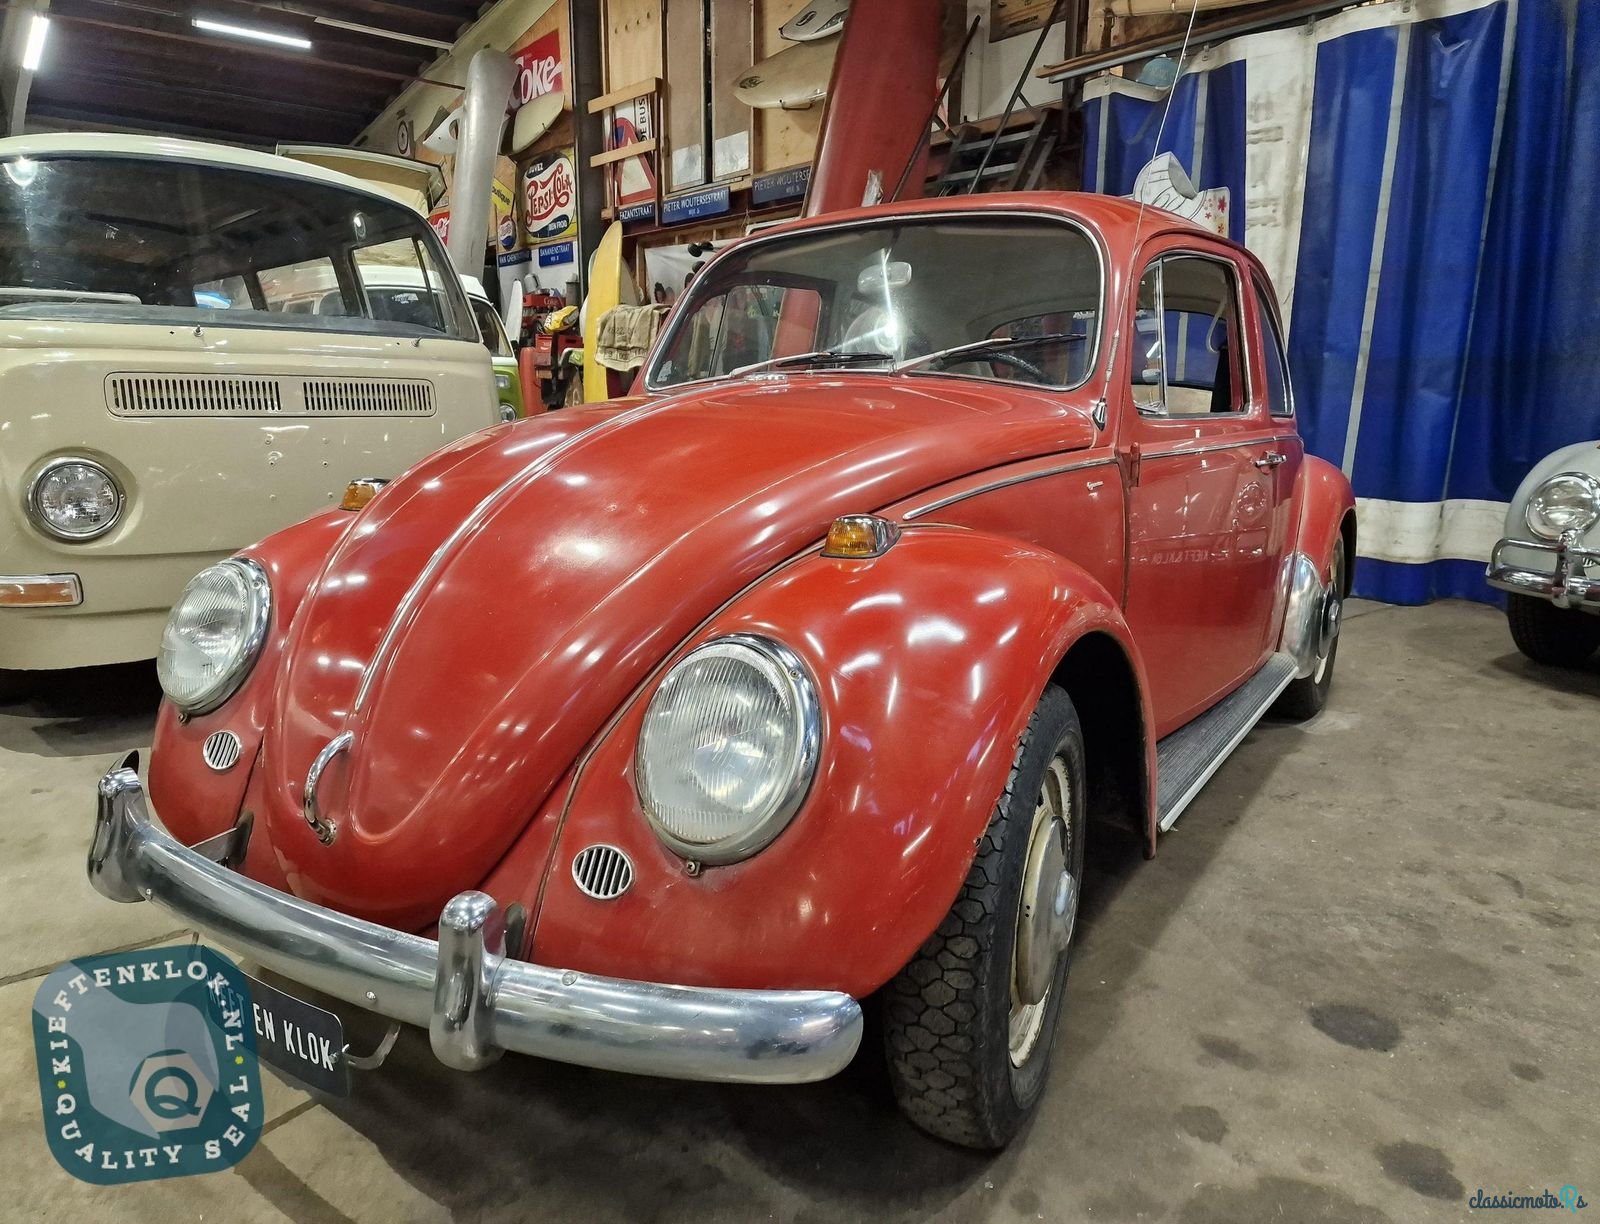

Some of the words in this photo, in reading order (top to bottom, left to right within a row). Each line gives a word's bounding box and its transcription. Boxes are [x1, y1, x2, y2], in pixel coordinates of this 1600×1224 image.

[638, 98, 647, 124] BUS
[619, 205, 653, 220] FAZANTSTRAAT
[663, 201, 681, 213] PIETER
[252, 1003, 277, 1043] EN
[283, 1019, 334, 1072] KLOK
